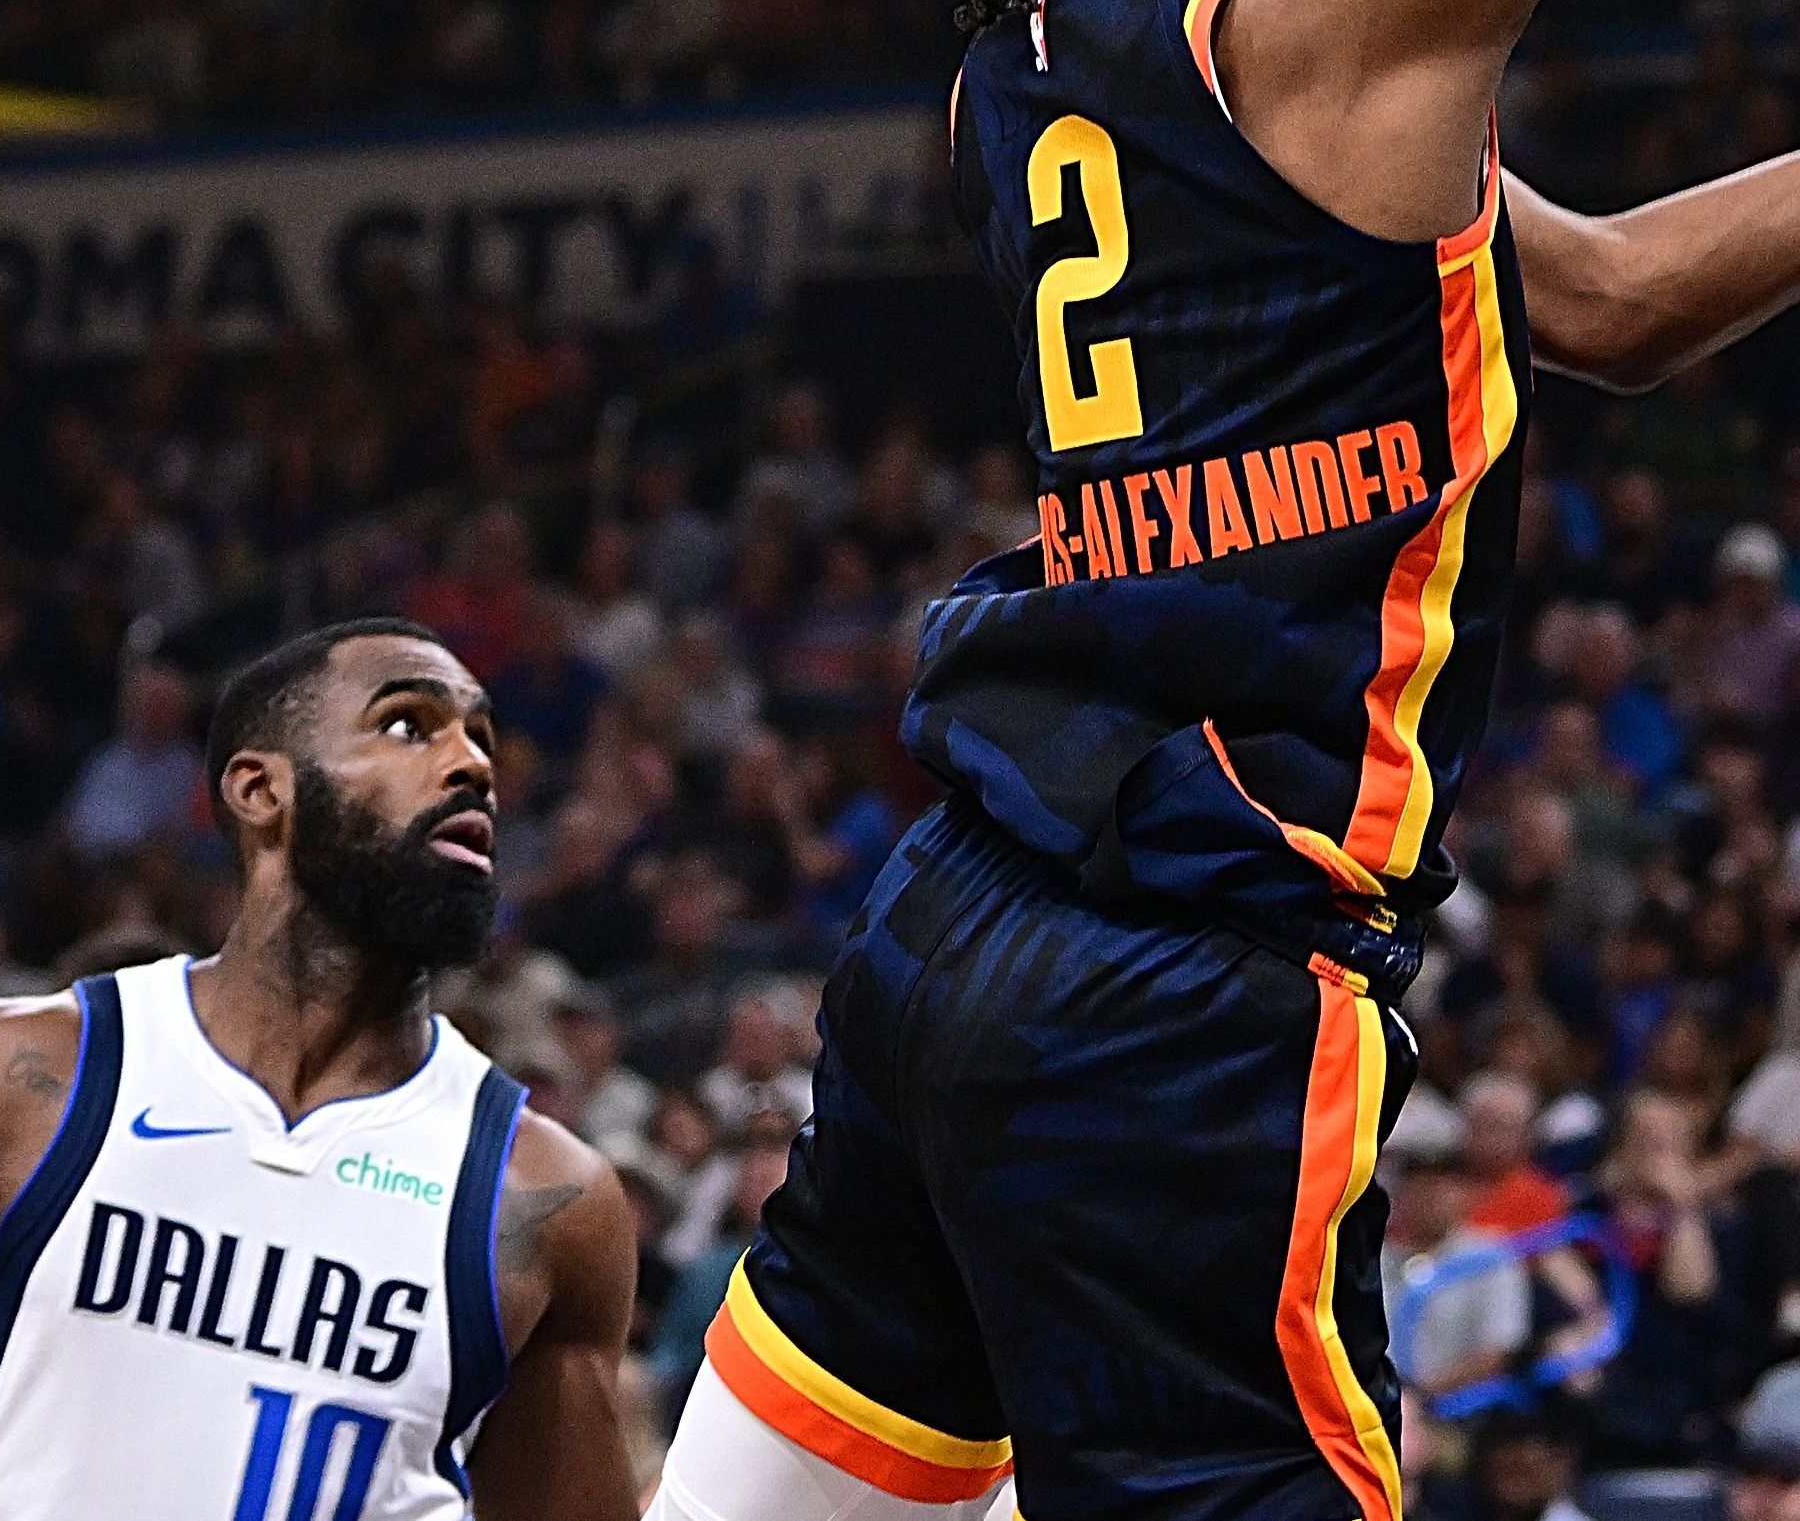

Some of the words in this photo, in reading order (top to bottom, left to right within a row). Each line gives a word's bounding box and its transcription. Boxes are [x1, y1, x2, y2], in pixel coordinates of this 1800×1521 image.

[333, 179, 697, 321] CITY
[1027, 115, 1144, 453] 2
[336, 1151, 444, 1206] chime
[72, 1201, 429, 1384] DALLAS
[231, 1384, 394, 1521] 10
